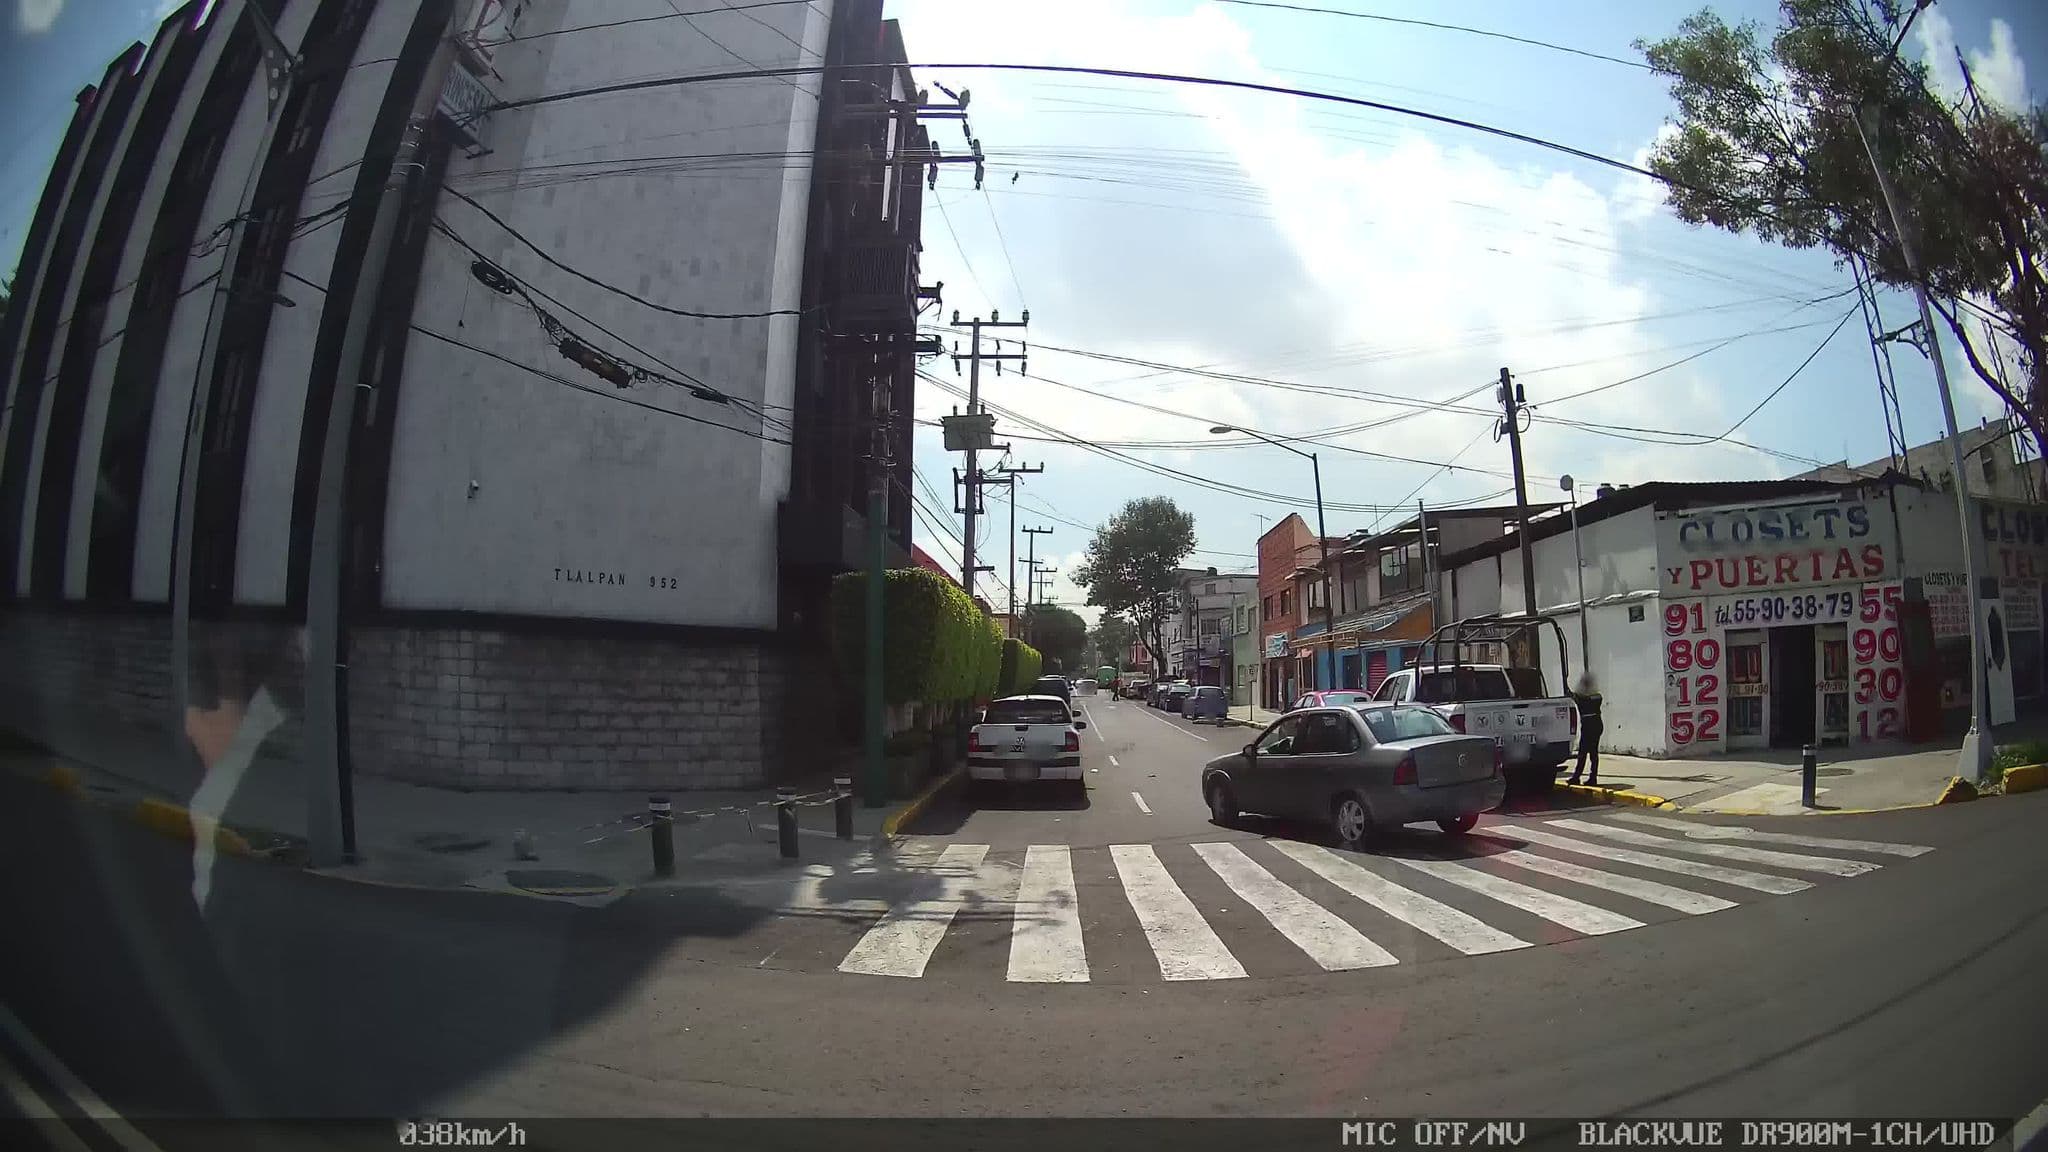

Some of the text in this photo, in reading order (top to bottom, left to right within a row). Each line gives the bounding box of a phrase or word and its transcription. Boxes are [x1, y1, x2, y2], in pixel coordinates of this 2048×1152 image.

[1679, 505, 1870, 546] CLOSETS
[554, 568, 677, 589] TLALPAN 952
[1667, 544, 1885, 590] Y PUERTAS
[1664, 602, 1708, 637] 91
[1859, 585, 1903, 624] 55
[1668, 638, 1720, 671] 80
[1854, 627, 1902, 665] 90
[1677, 674, 1719, 706] 12
[1854, 667, 1902, 704] 30
[1671, 709, 1721, 744] 52
[1857, 707, 1901, 742] 12
